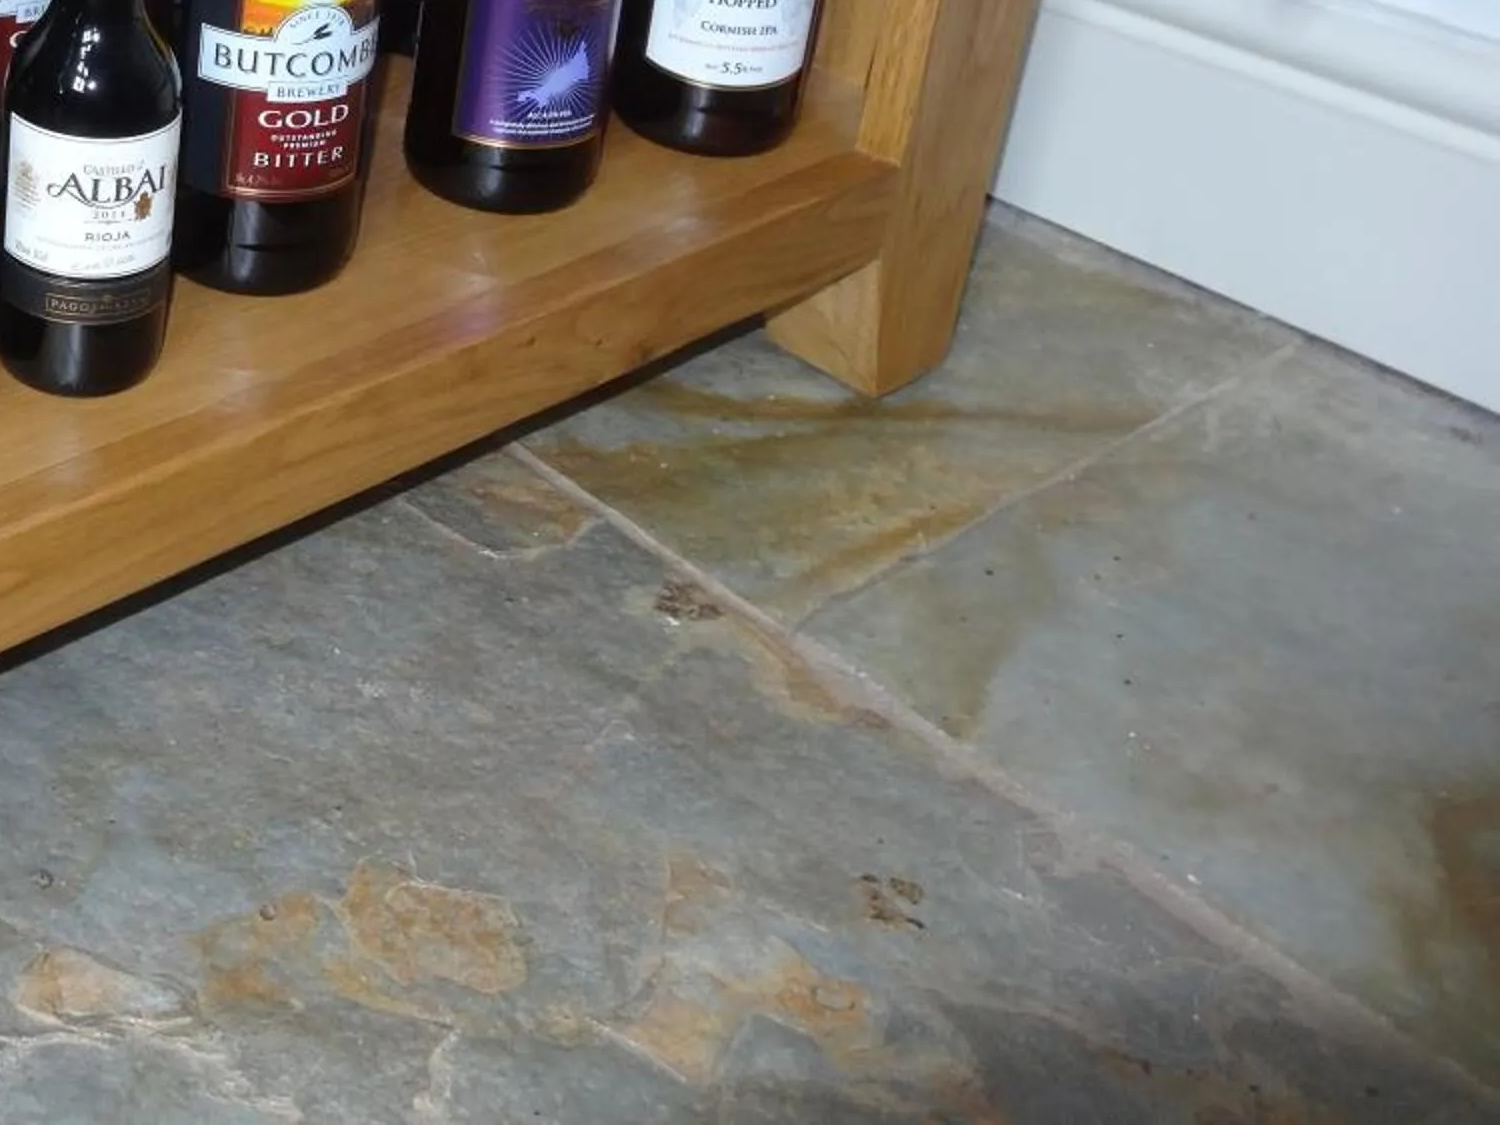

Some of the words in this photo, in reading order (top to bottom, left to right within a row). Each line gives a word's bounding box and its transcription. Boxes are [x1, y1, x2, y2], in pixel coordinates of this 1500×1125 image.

[277, 84, 340, 98] BREWERY
[258, 104, 349, 129] GOLD
[254, 146, 344, 168] BITTER
[84, 230, 131, 242] RIOJA
